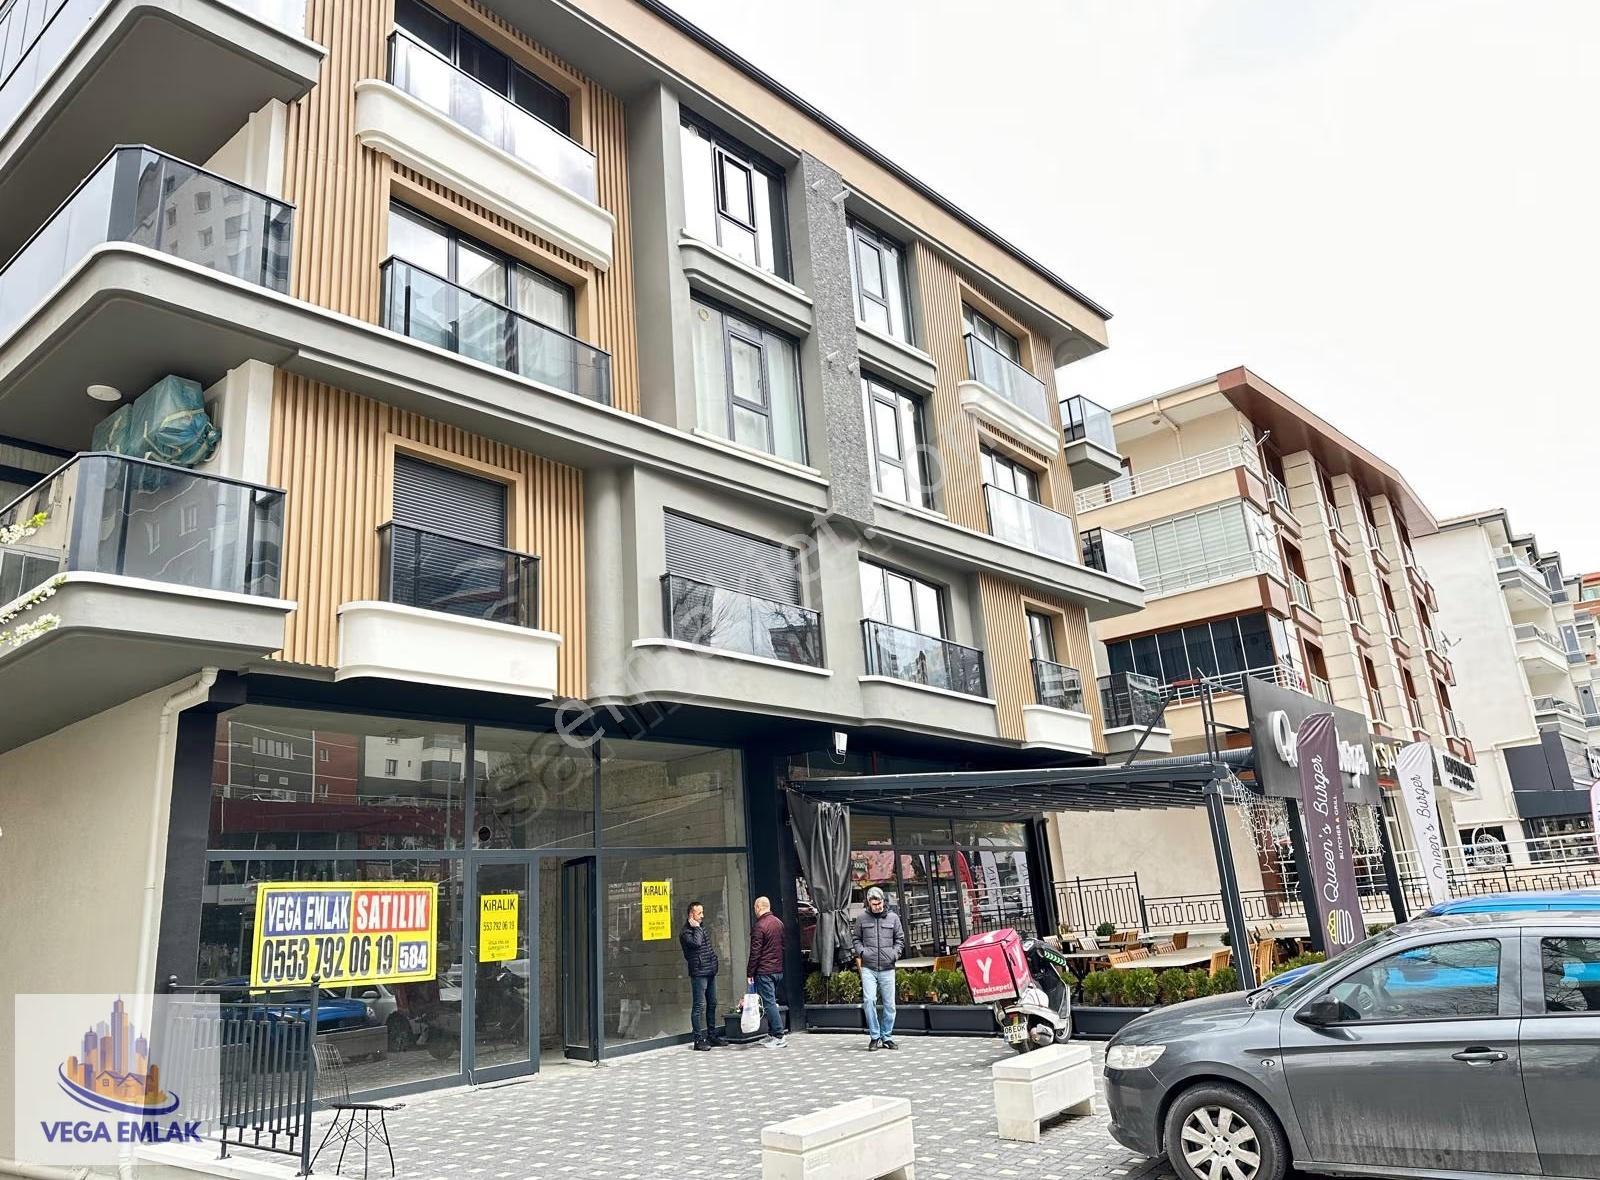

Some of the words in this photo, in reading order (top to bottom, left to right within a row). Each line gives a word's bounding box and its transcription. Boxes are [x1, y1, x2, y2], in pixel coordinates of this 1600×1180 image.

[1312, 754, 1330, 817] Burger
[1410, 774, 1430, 818] Burger
[1319, 823, 1339, 903] Queen's
[268, 896, 302, 932] VEGA
[305, 895, 350, 931] EMLAK
[356, 894, 428, 930] SATILIK
[261, 937, 309, 983] 0553
[314, 936, 346, 978] 792
[350, 935, 371, 976] 06
[376, 934, 394, 975] 19
[400, 944, 427, 970] 584
